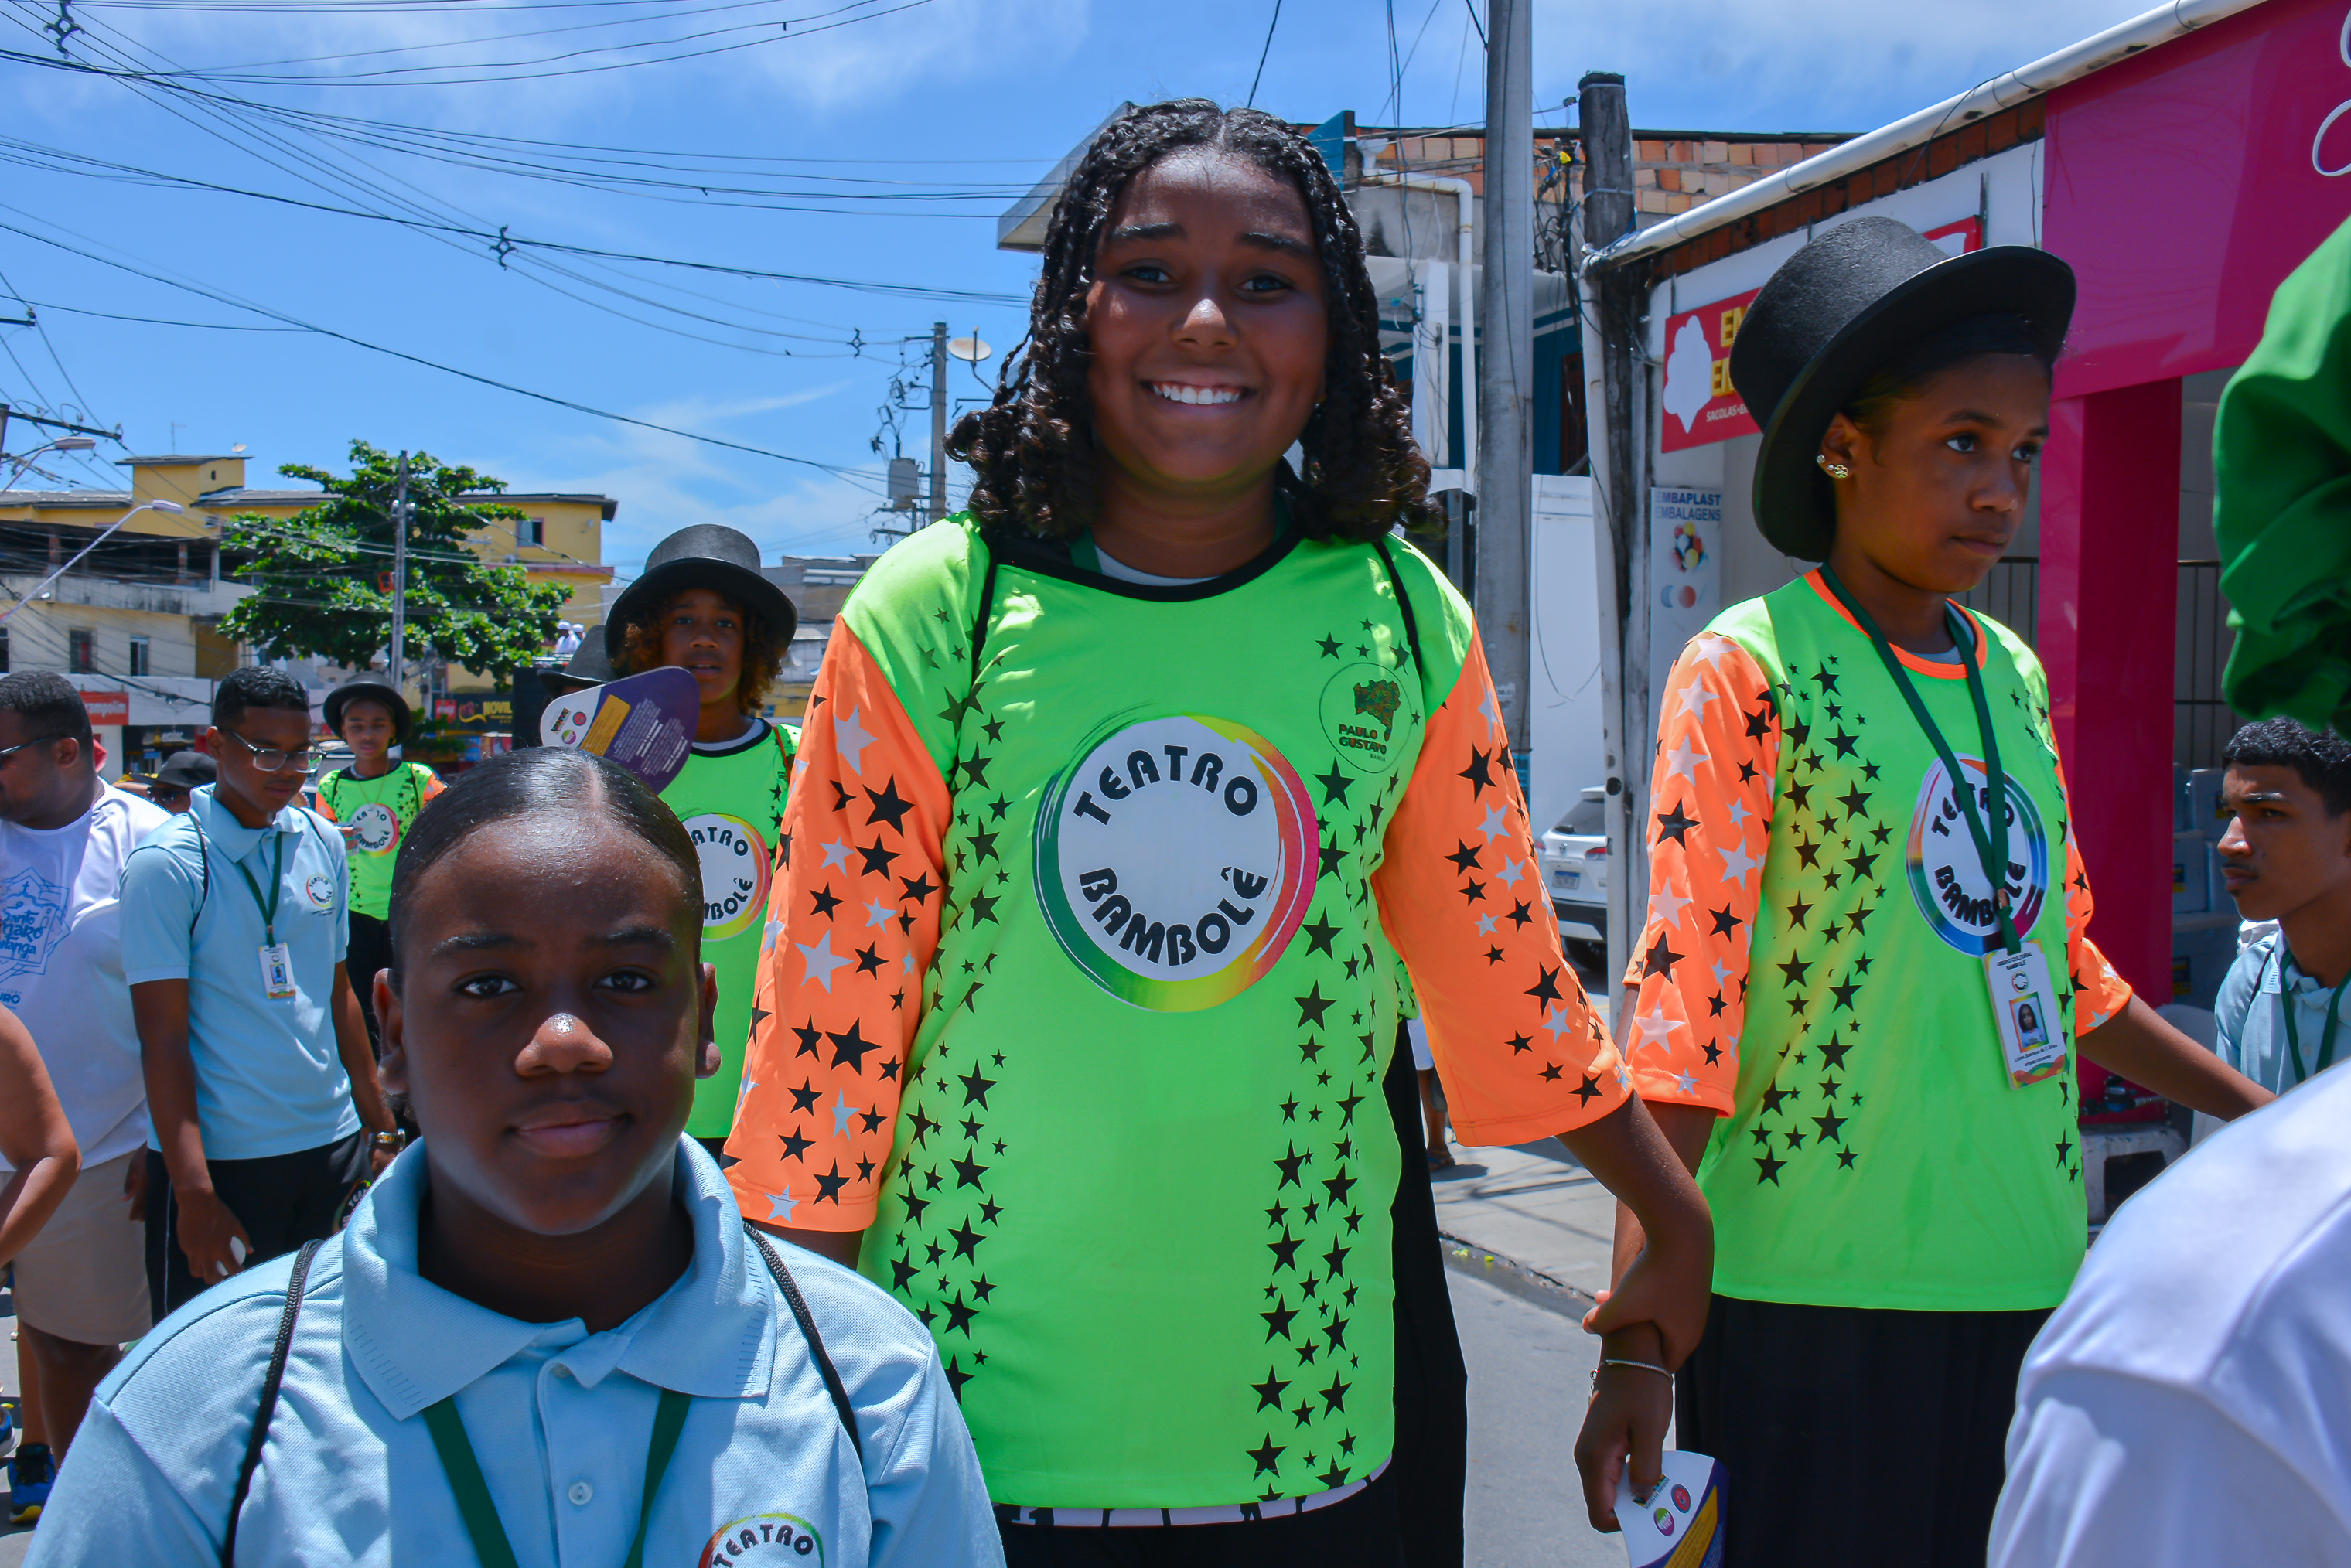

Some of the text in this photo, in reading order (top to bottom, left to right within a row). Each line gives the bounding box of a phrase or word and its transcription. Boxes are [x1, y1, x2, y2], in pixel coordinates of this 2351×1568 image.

[1657, 491, 1721, 506] EMBAPLAST
[1656, 506, 1721, 522] EMBALAGENS
[1339, 724, 1378, 739] PAULO
[1339, 736, 1387, 755] GUSTAVO
[1073, 745, 1258, 826] TEATRO
[691, 827, 749, 856] ATRO
[704, 877, 753, 920] BOLÊ
[1079, 865, 1268, 966] BAMBOLÊ
[713, 1523, 814, 1568] TEATRO
